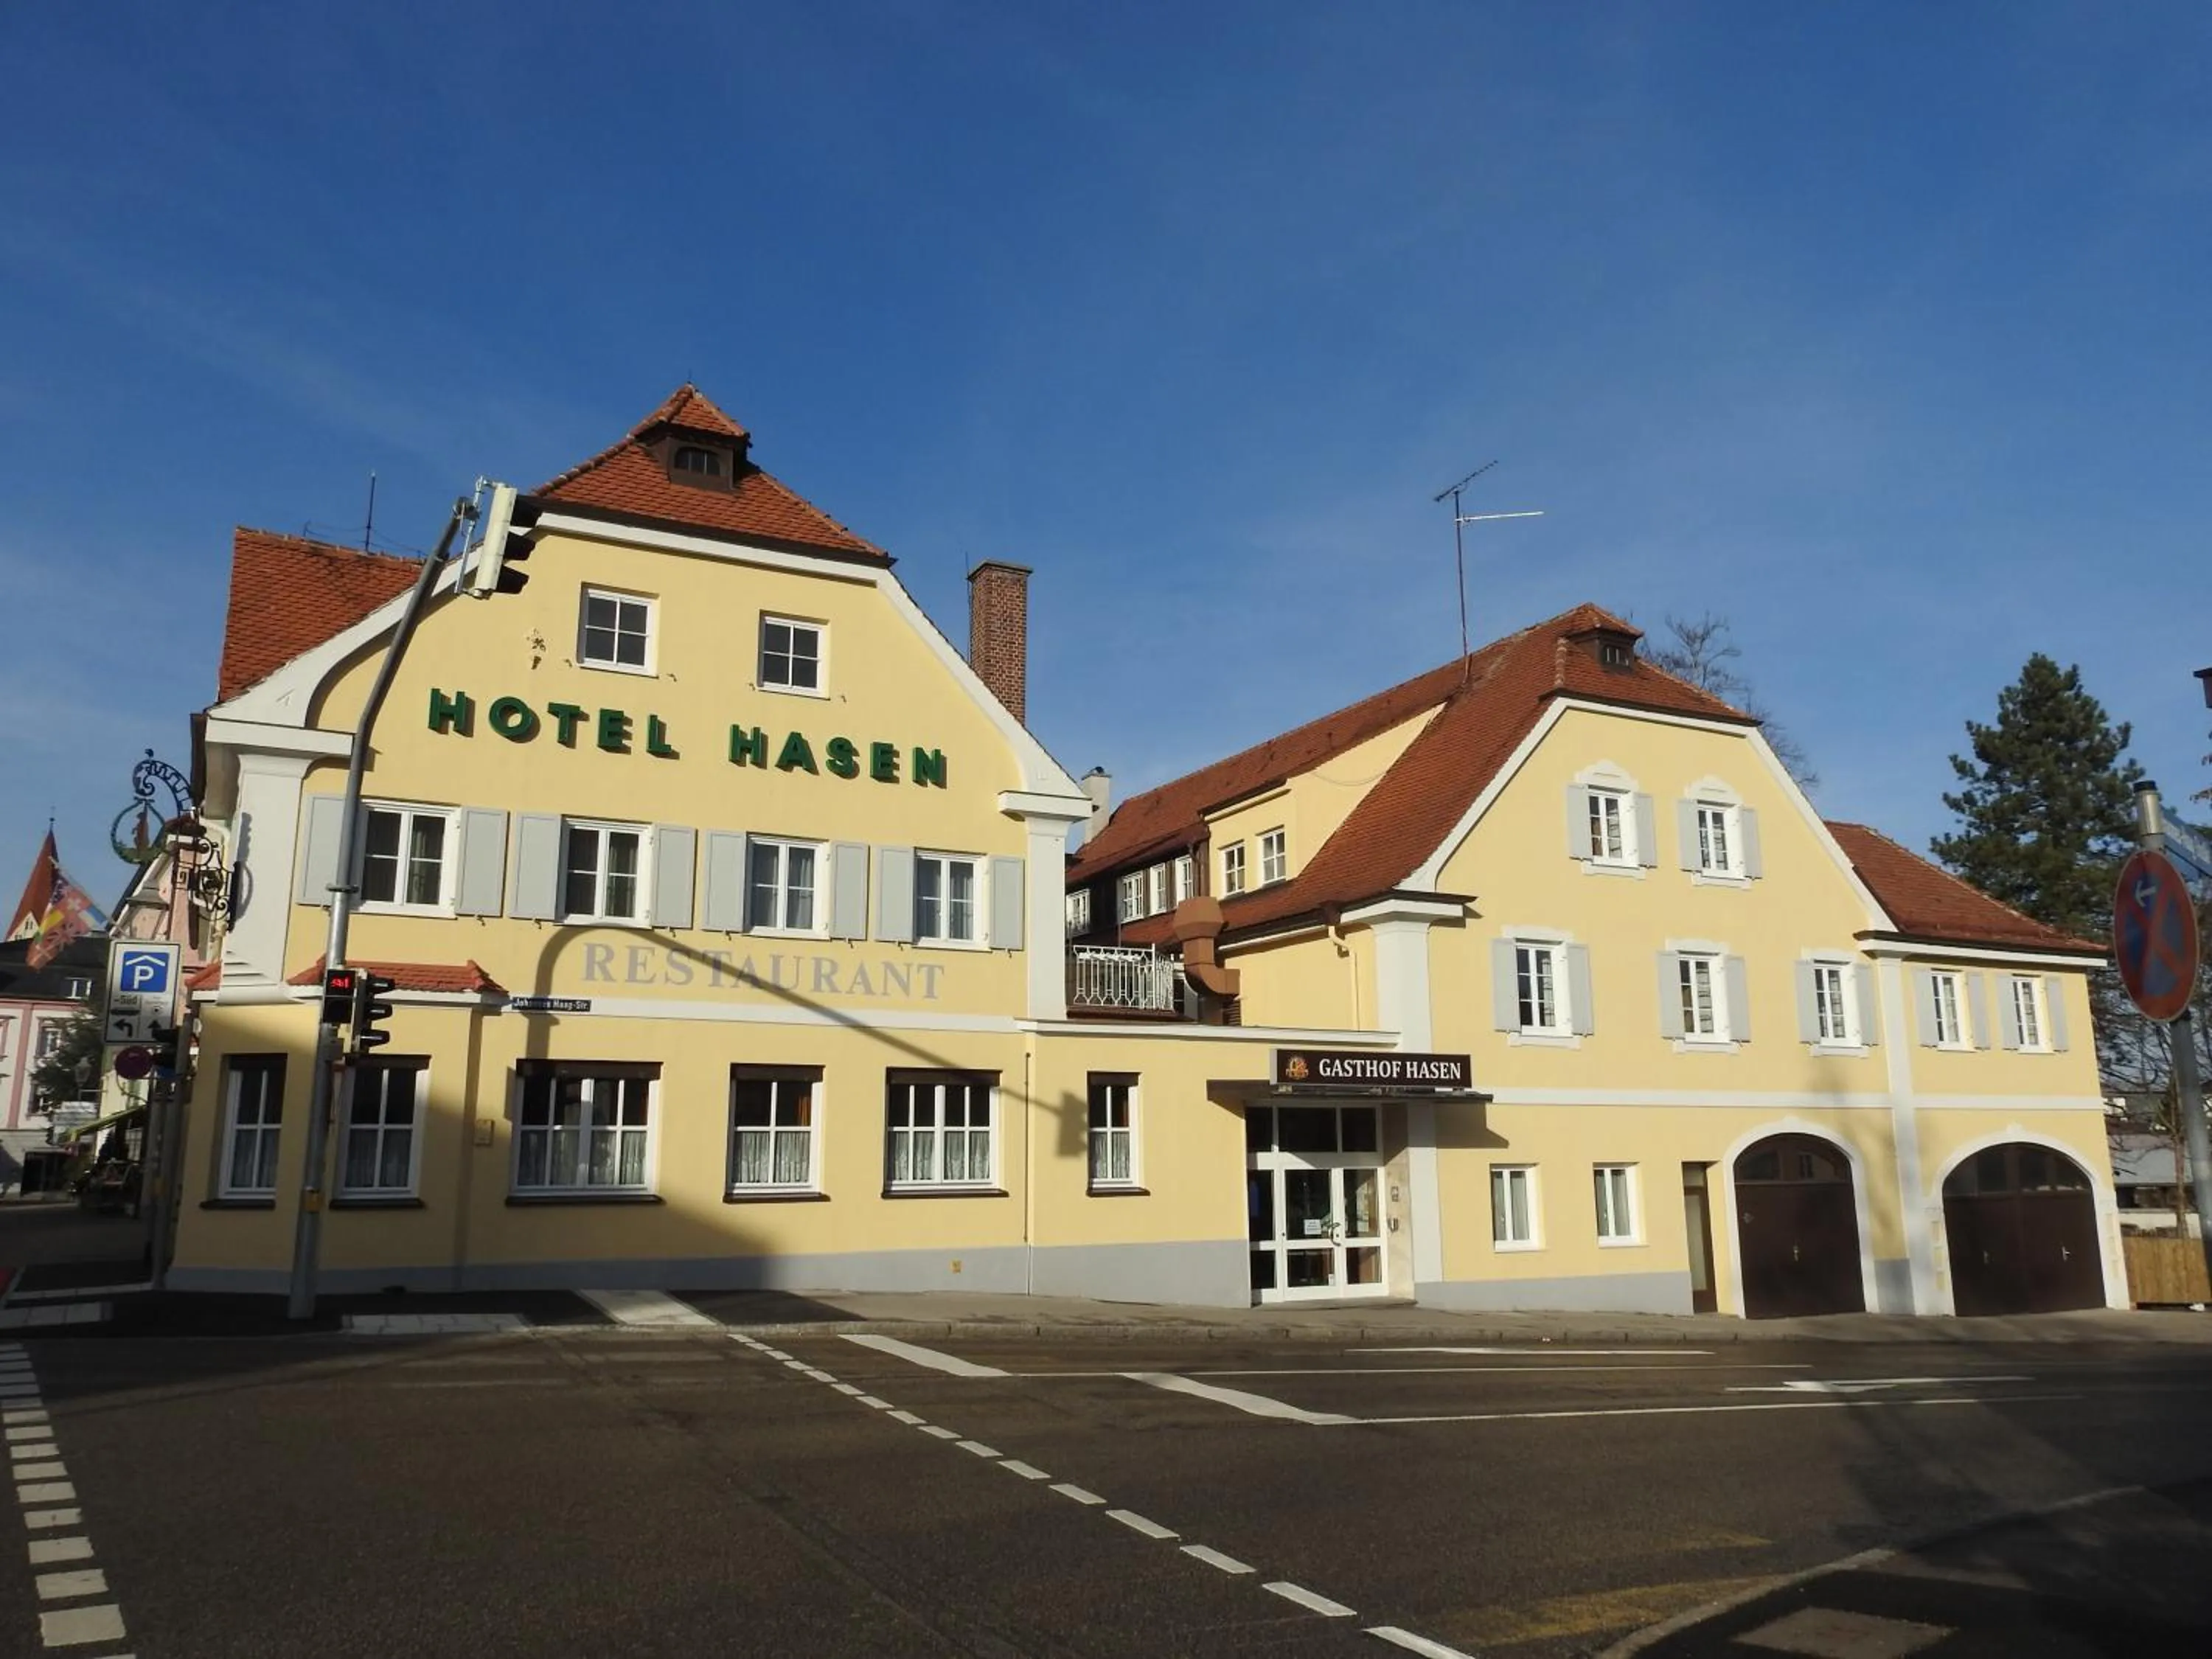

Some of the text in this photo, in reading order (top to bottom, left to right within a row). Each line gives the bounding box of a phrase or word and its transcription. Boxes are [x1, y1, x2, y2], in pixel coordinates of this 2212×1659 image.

[428, 688, 944, 787] HOTEL HASEN
[133, 965, 154, 989] P
[580, 942, 945, 999] RESTAURANT
[1319, 1059, 1401, 1078] GASTHOF
[1406, 1061, 1461, 1079] HASEN
